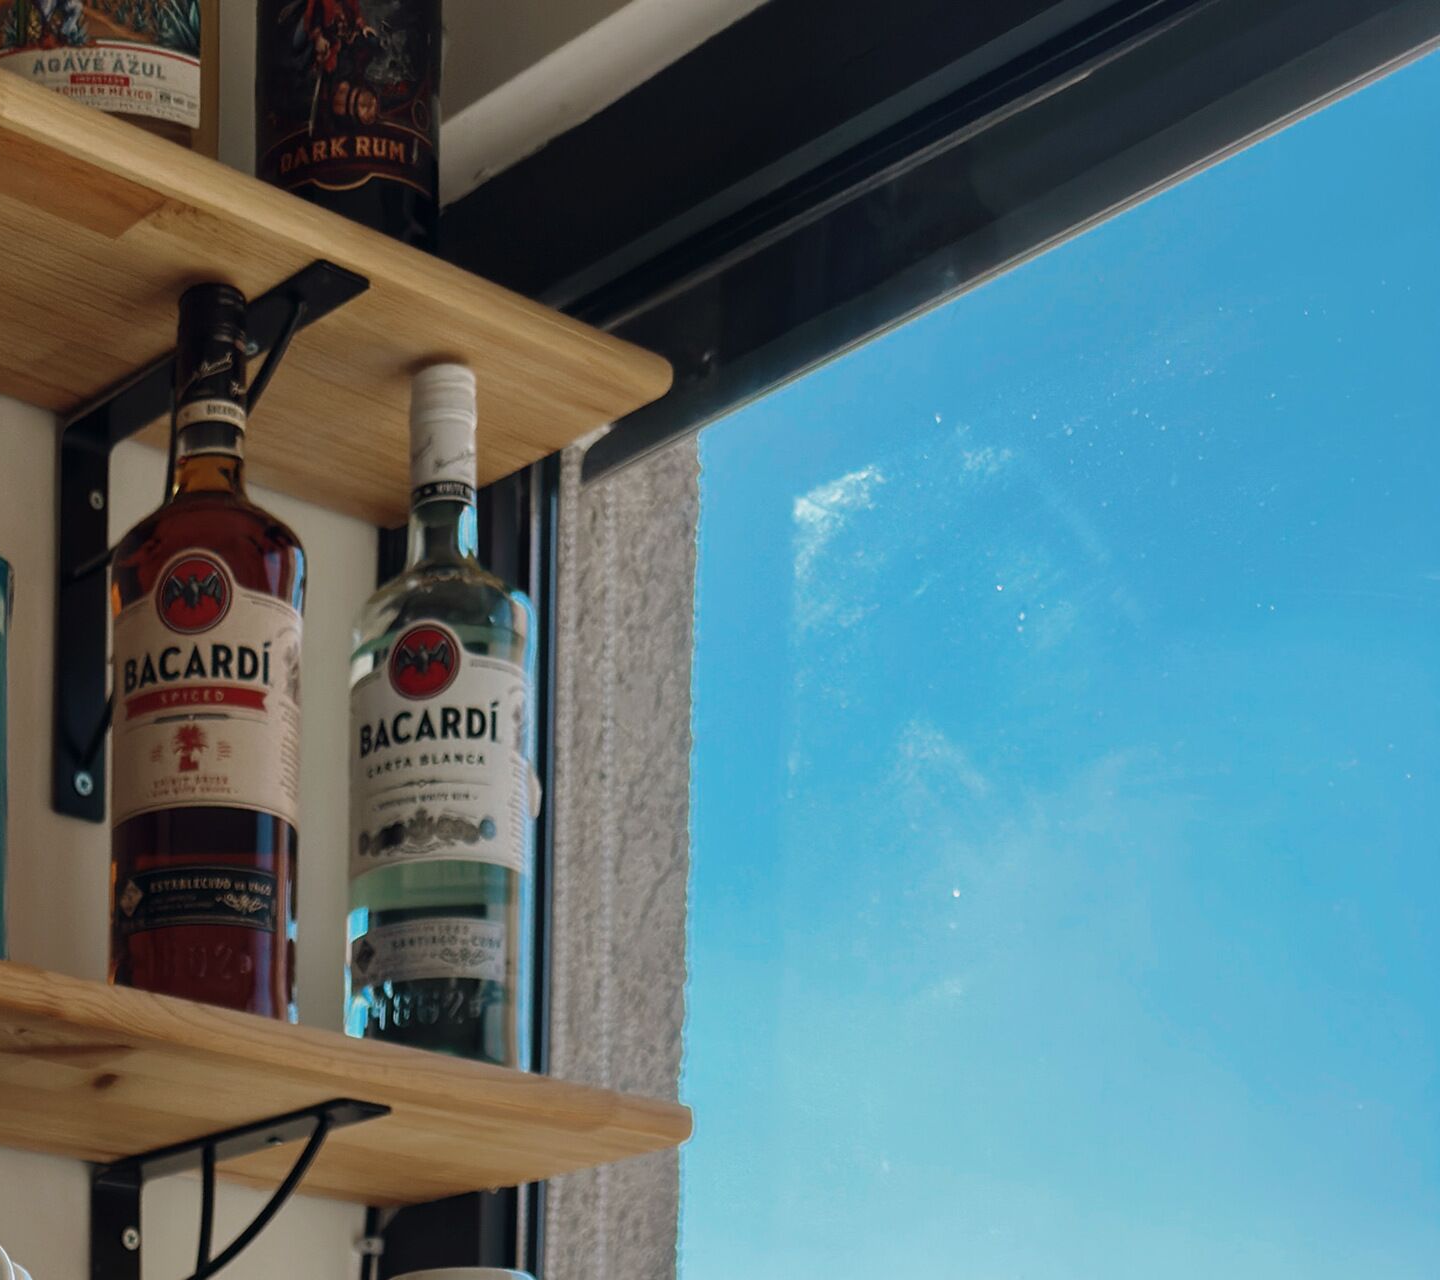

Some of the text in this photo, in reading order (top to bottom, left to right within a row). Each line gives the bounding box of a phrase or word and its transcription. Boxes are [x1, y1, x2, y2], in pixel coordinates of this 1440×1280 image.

[33, 57, 167, 80] AGAVE AZUL
[280, 136, 406, 174] DARK RUM
[124, 641, 272, 694] BACARDÍ
[360, 701, 499, 759] BACARDÍ
[367, 751, 486, 779] CARTA BLANCA
